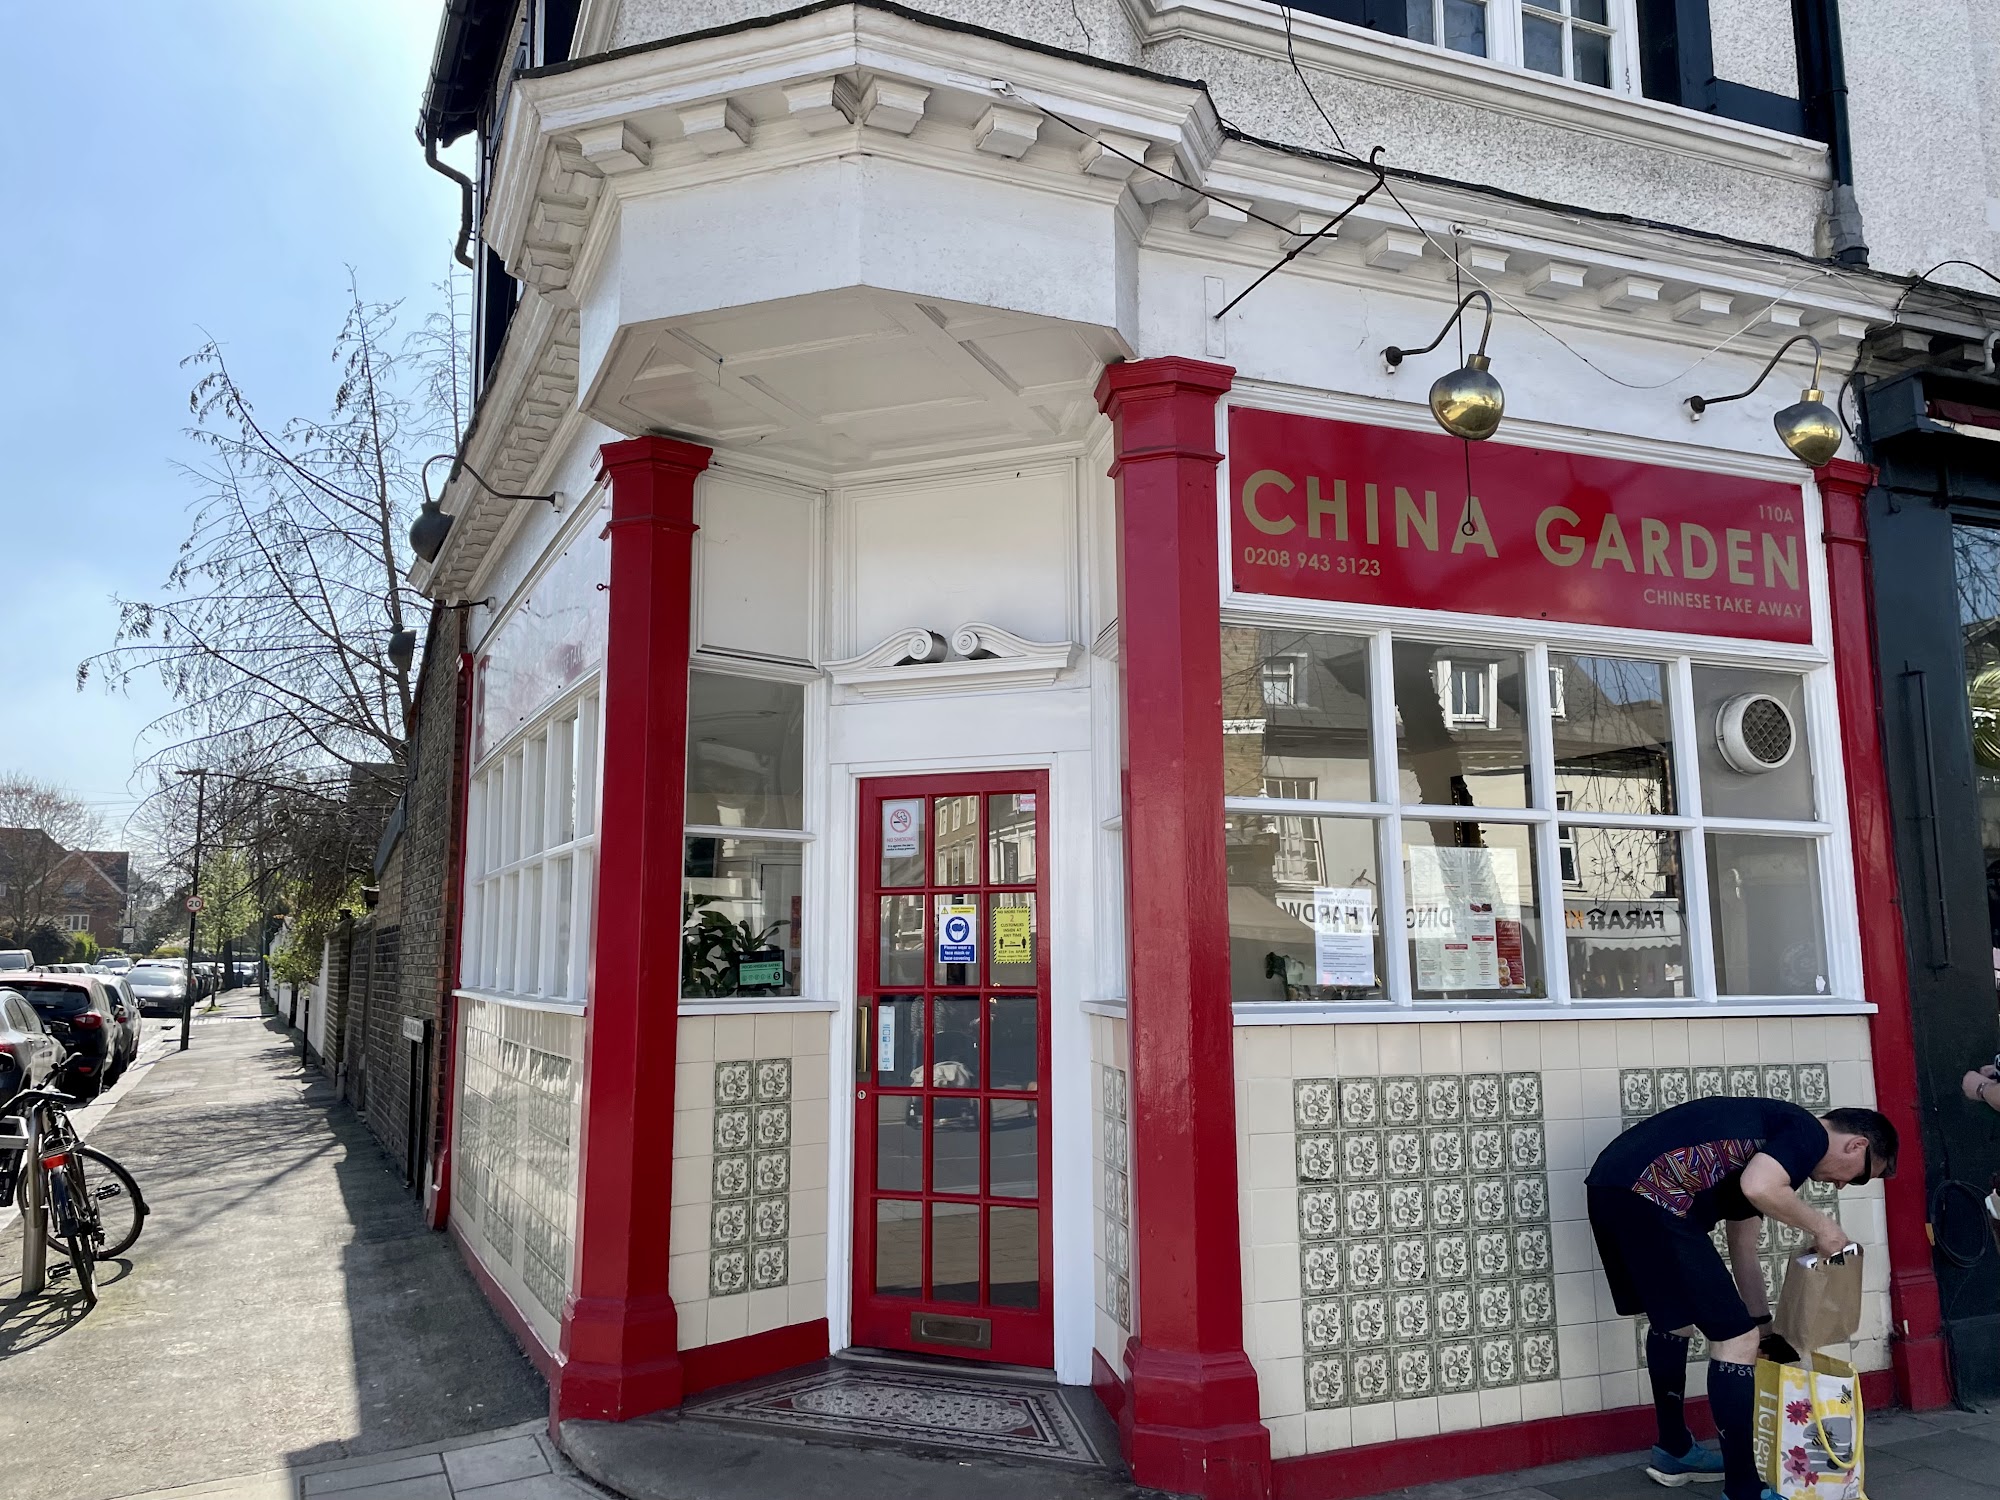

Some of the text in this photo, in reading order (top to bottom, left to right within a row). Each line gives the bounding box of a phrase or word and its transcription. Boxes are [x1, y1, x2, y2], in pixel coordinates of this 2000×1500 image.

[1758, 504, 1794, 524] 110A
[1242, 469, 1799, 590] CHINA GARDEN
[1244, 547, 1381, 576] 0208 943 3123
[1643, 588, 1803, 618] CHINESE TAKE AWAY
[188, 900, 200, 908] 20
